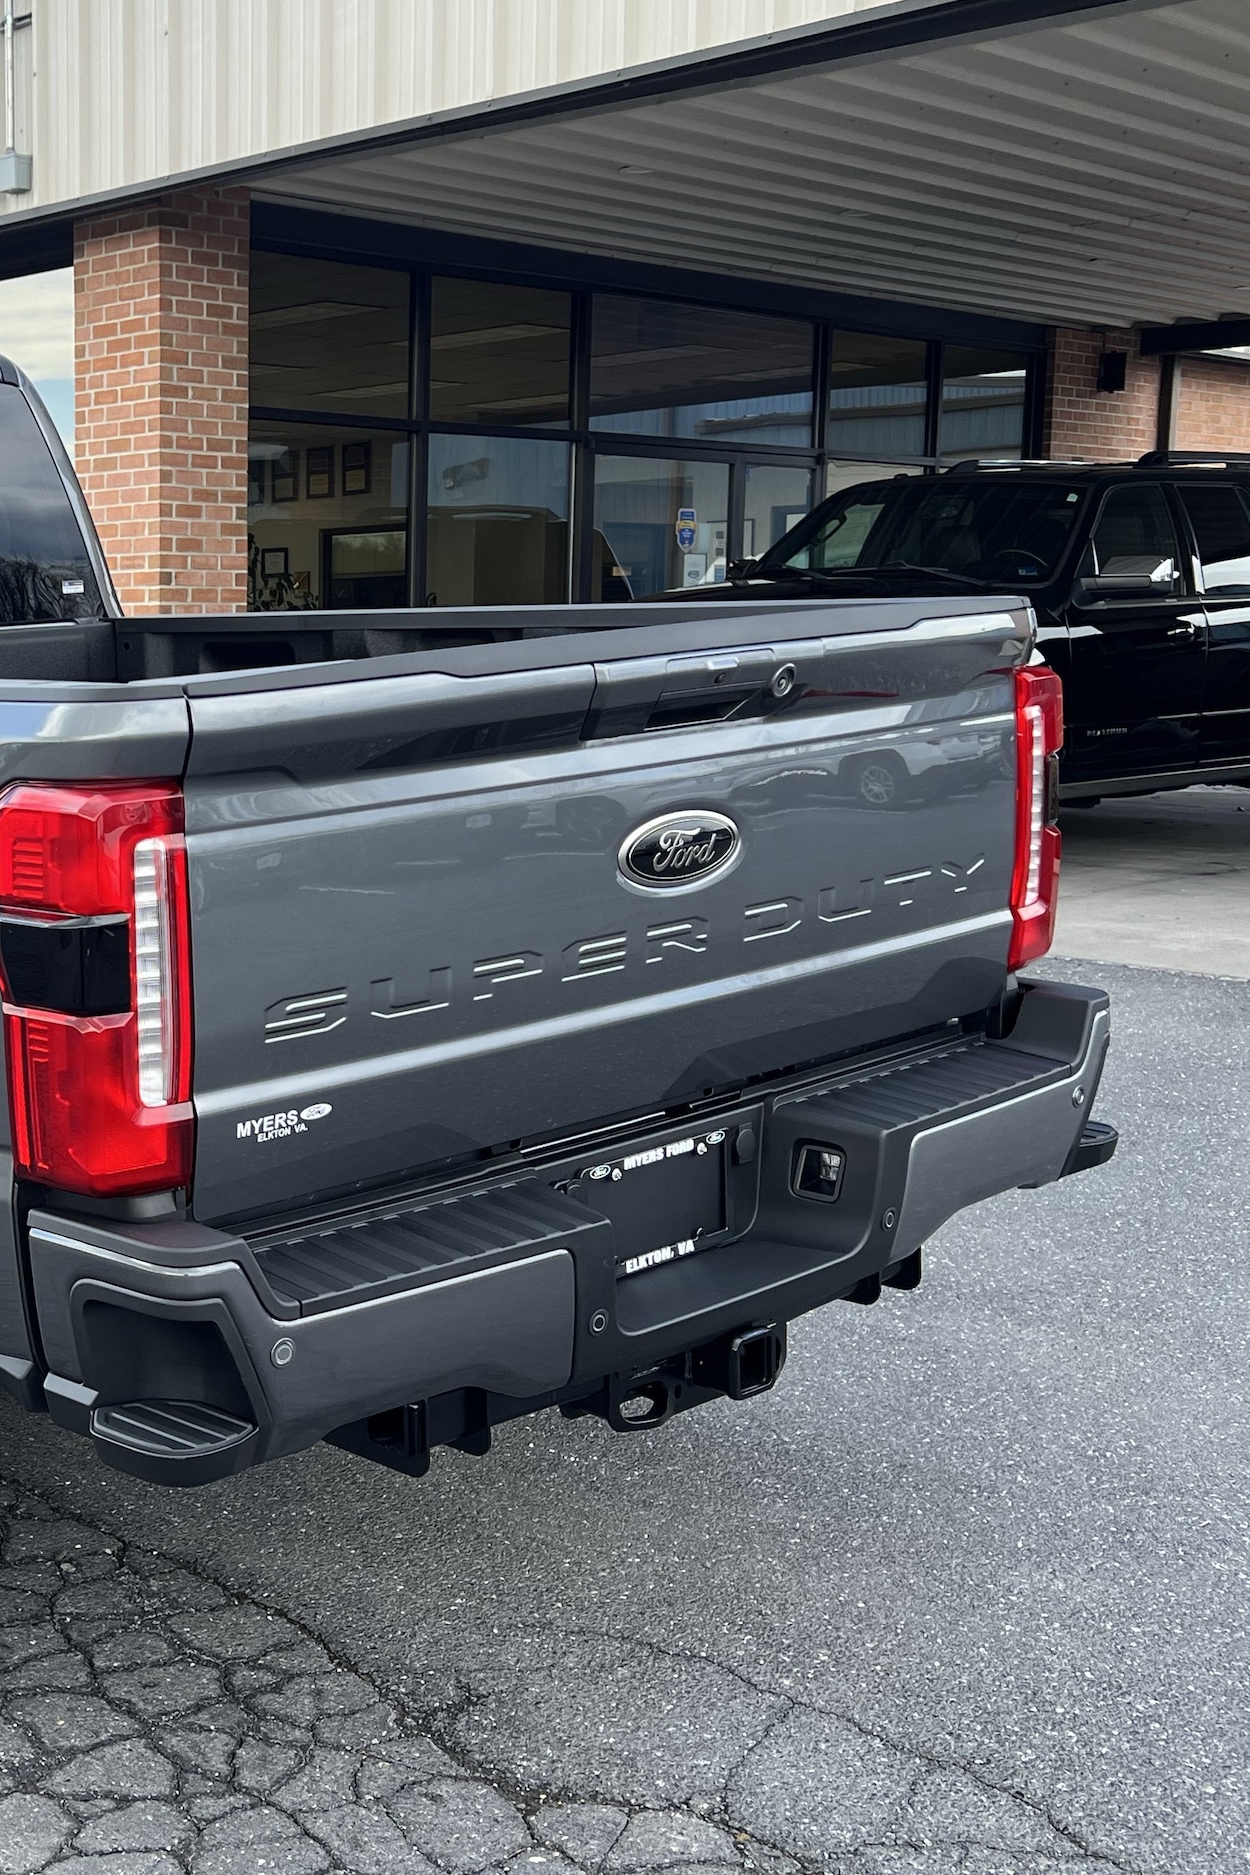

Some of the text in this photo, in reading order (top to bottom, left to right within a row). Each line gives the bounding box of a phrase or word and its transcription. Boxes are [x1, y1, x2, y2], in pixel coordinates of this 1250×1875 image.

[652, 826, 718, 873] Ford
[263, 853, 986, 1044] SUPER DUTY
[236, 1109, 299, 1139] MYERS
[257, 1126, 292, 1143] ELKTON
[623, 1138, 695, 1171] MYERS FORD
[677, 1238, 695, 1257] VA
